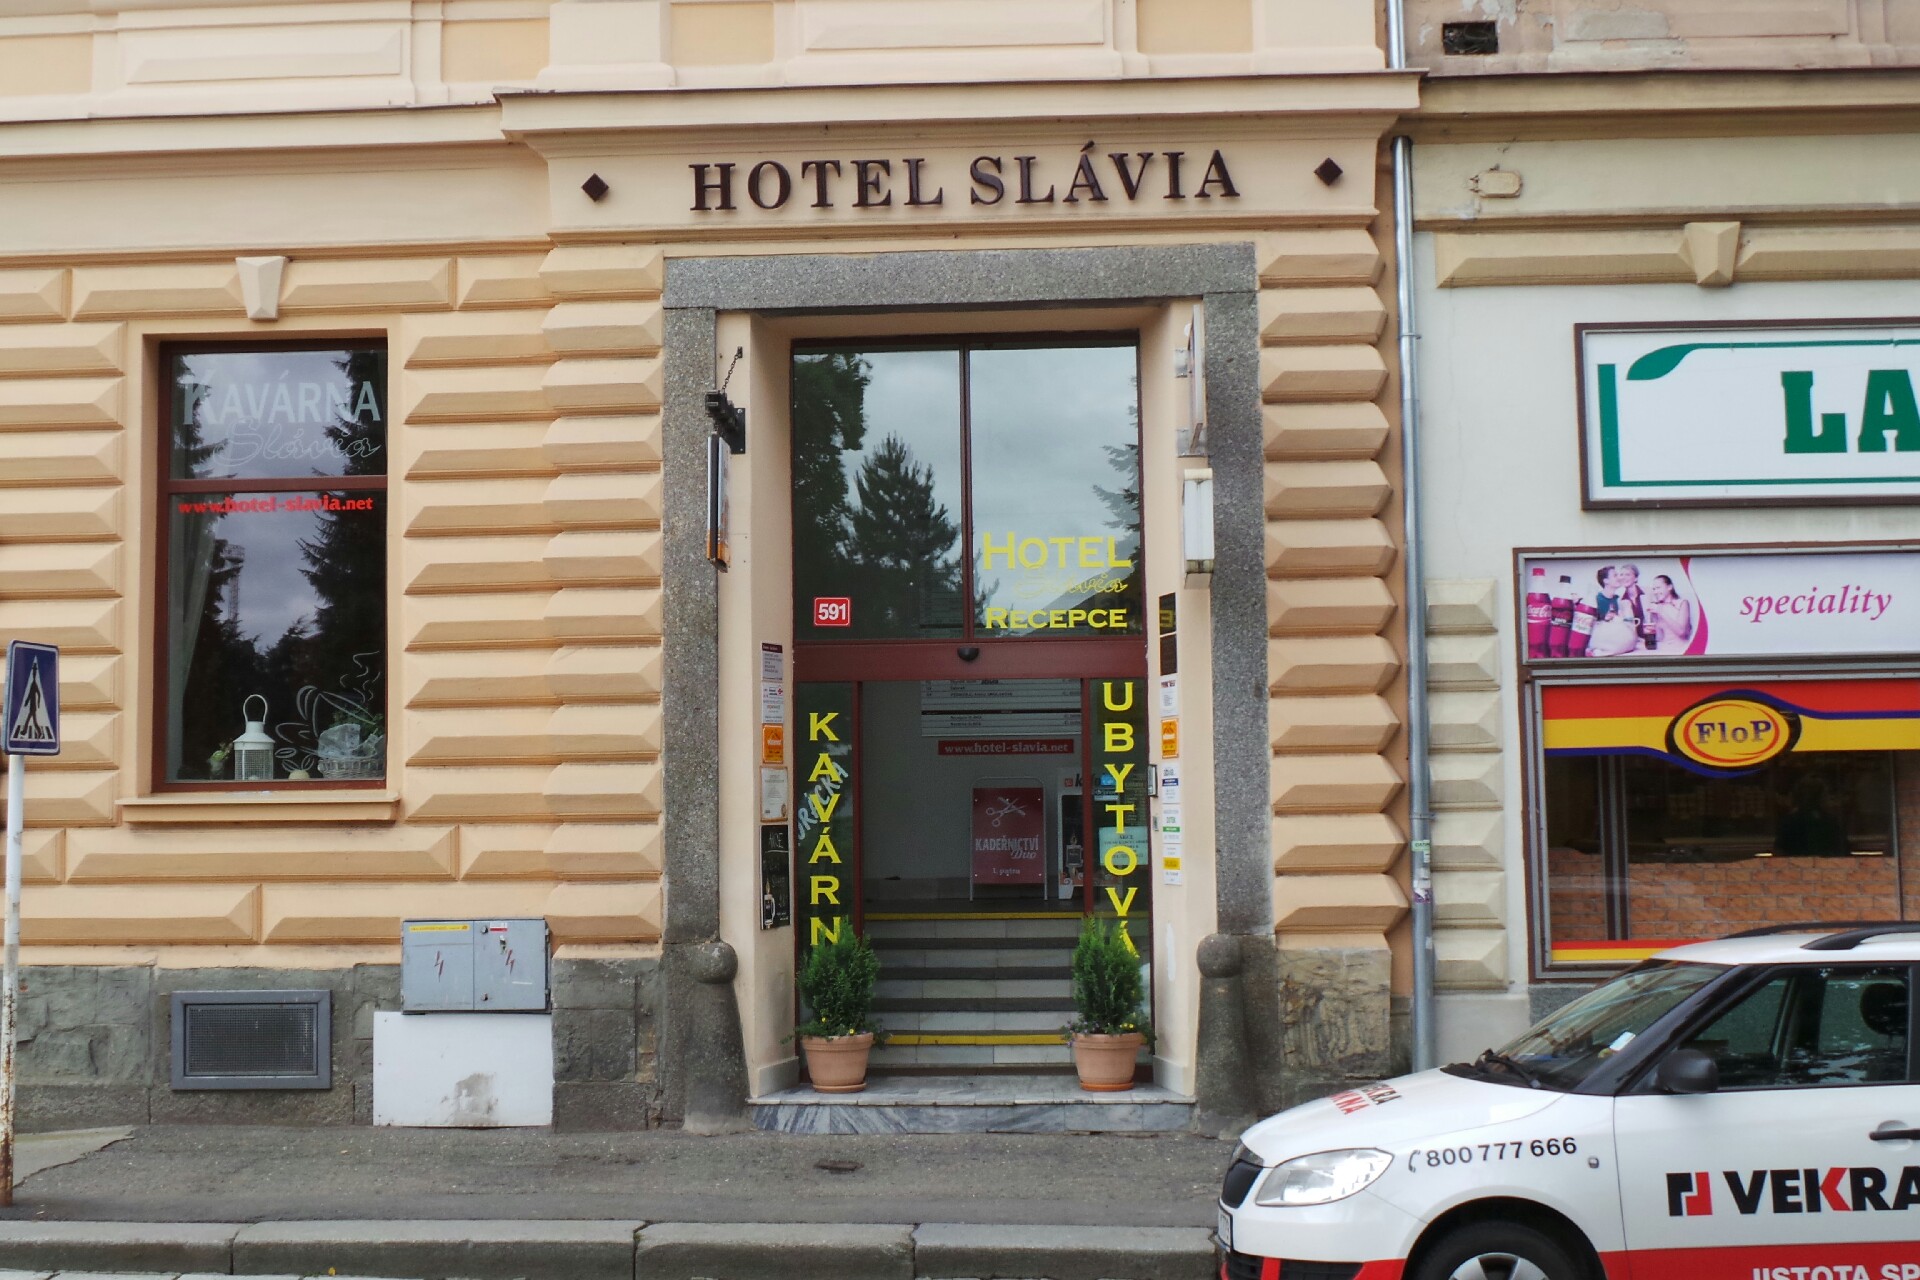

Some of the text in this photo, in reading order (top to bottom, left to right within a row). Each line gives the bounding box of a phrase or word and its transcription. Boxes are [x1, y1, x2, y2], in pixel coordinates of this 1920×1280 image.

[688, 140, 1241, 211] HOTEL SLÁVIA
[184, 369, 381, 425] KAVÁRNA
[1780, 368, 1920, 454] LA
[178, 494, 374, 513] www.hotel-slavia.net
[982, 530, 1132, 570] HOTEL
[818, 603, 847, 621] 591
[984, 607, 1128, 630] RECEPCE
[1739, 584, 1893, 623] speciality
[945, 742, 1068, 753] www.hotel-slavia.net
[1695, 719, 1773, 745] FloP
[1426, 1136, 1578, 1167] 800 777 666
[1722, 1165, 1920, 1215] VEKRA
